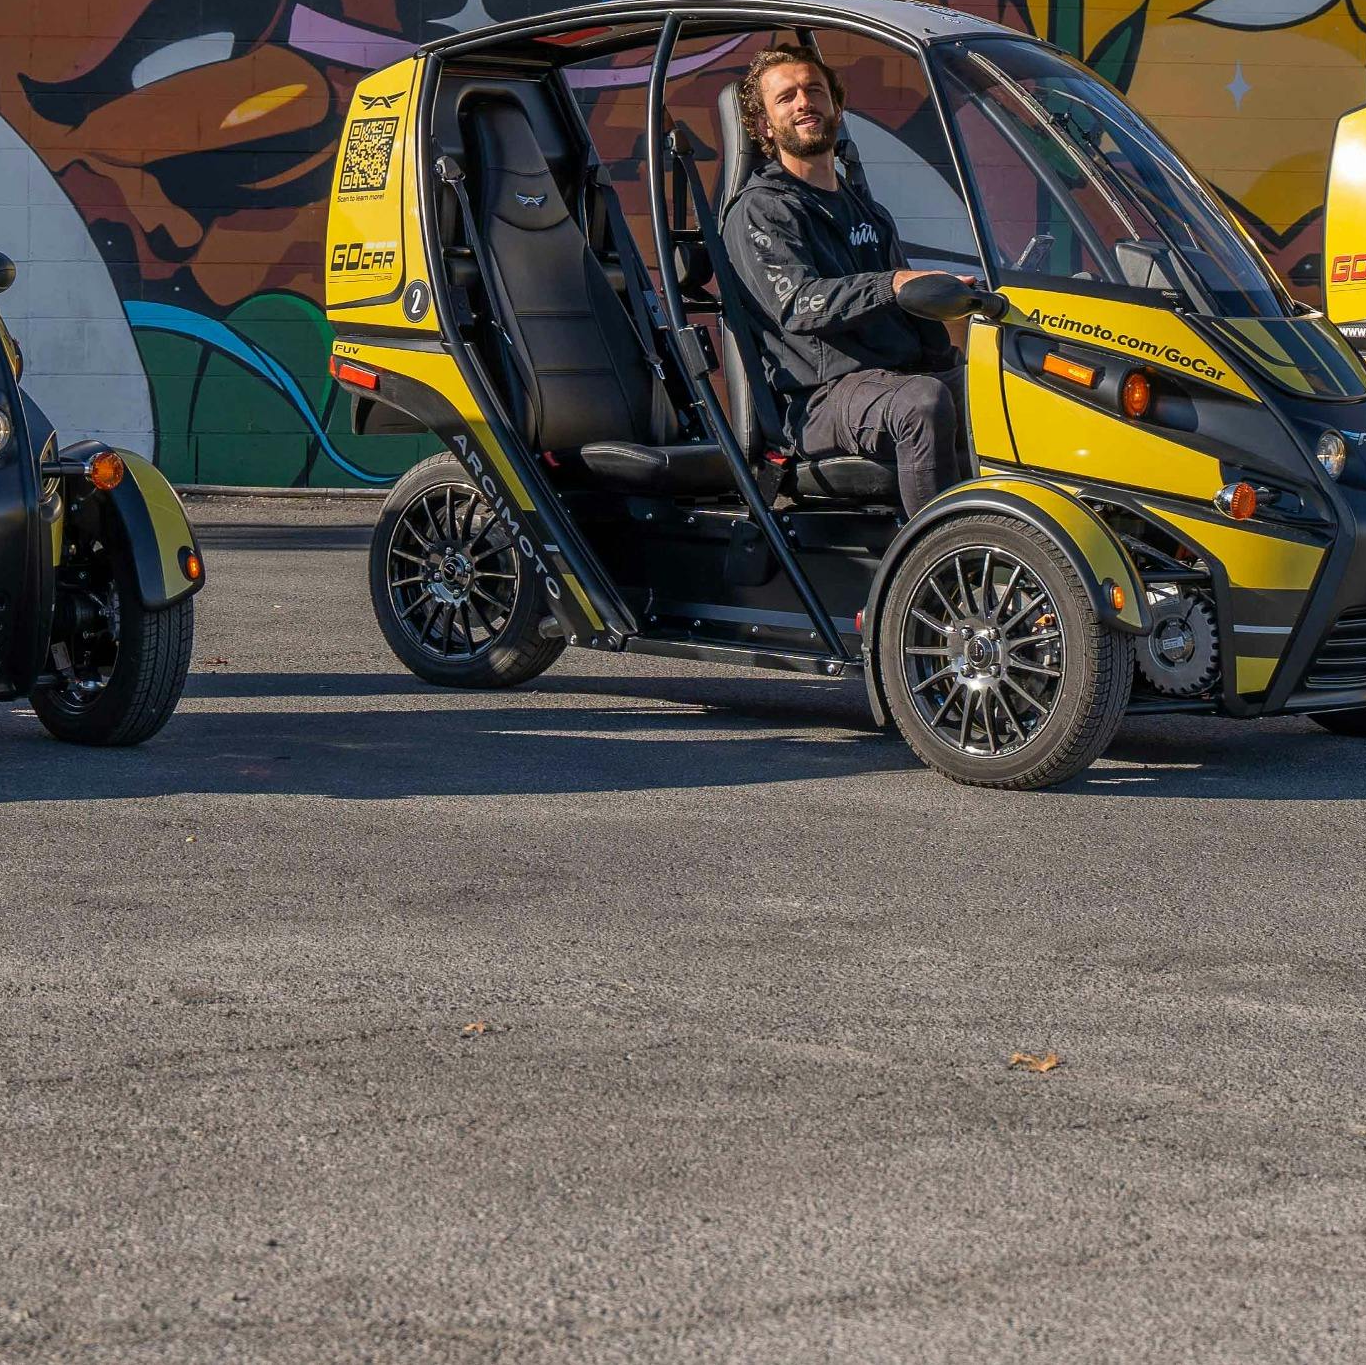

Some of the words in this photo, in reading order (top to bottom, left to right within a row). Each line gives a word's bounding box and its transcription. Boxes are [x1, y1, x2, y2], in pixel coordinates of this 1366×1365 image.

[410, 288, 422, 315] 2
[334, 344, 360, 355] FUV
[1025, 308, 1226, 381] Arcimoto.com/GoCar
[452, 434, 562, 600] ARCIMOTO
